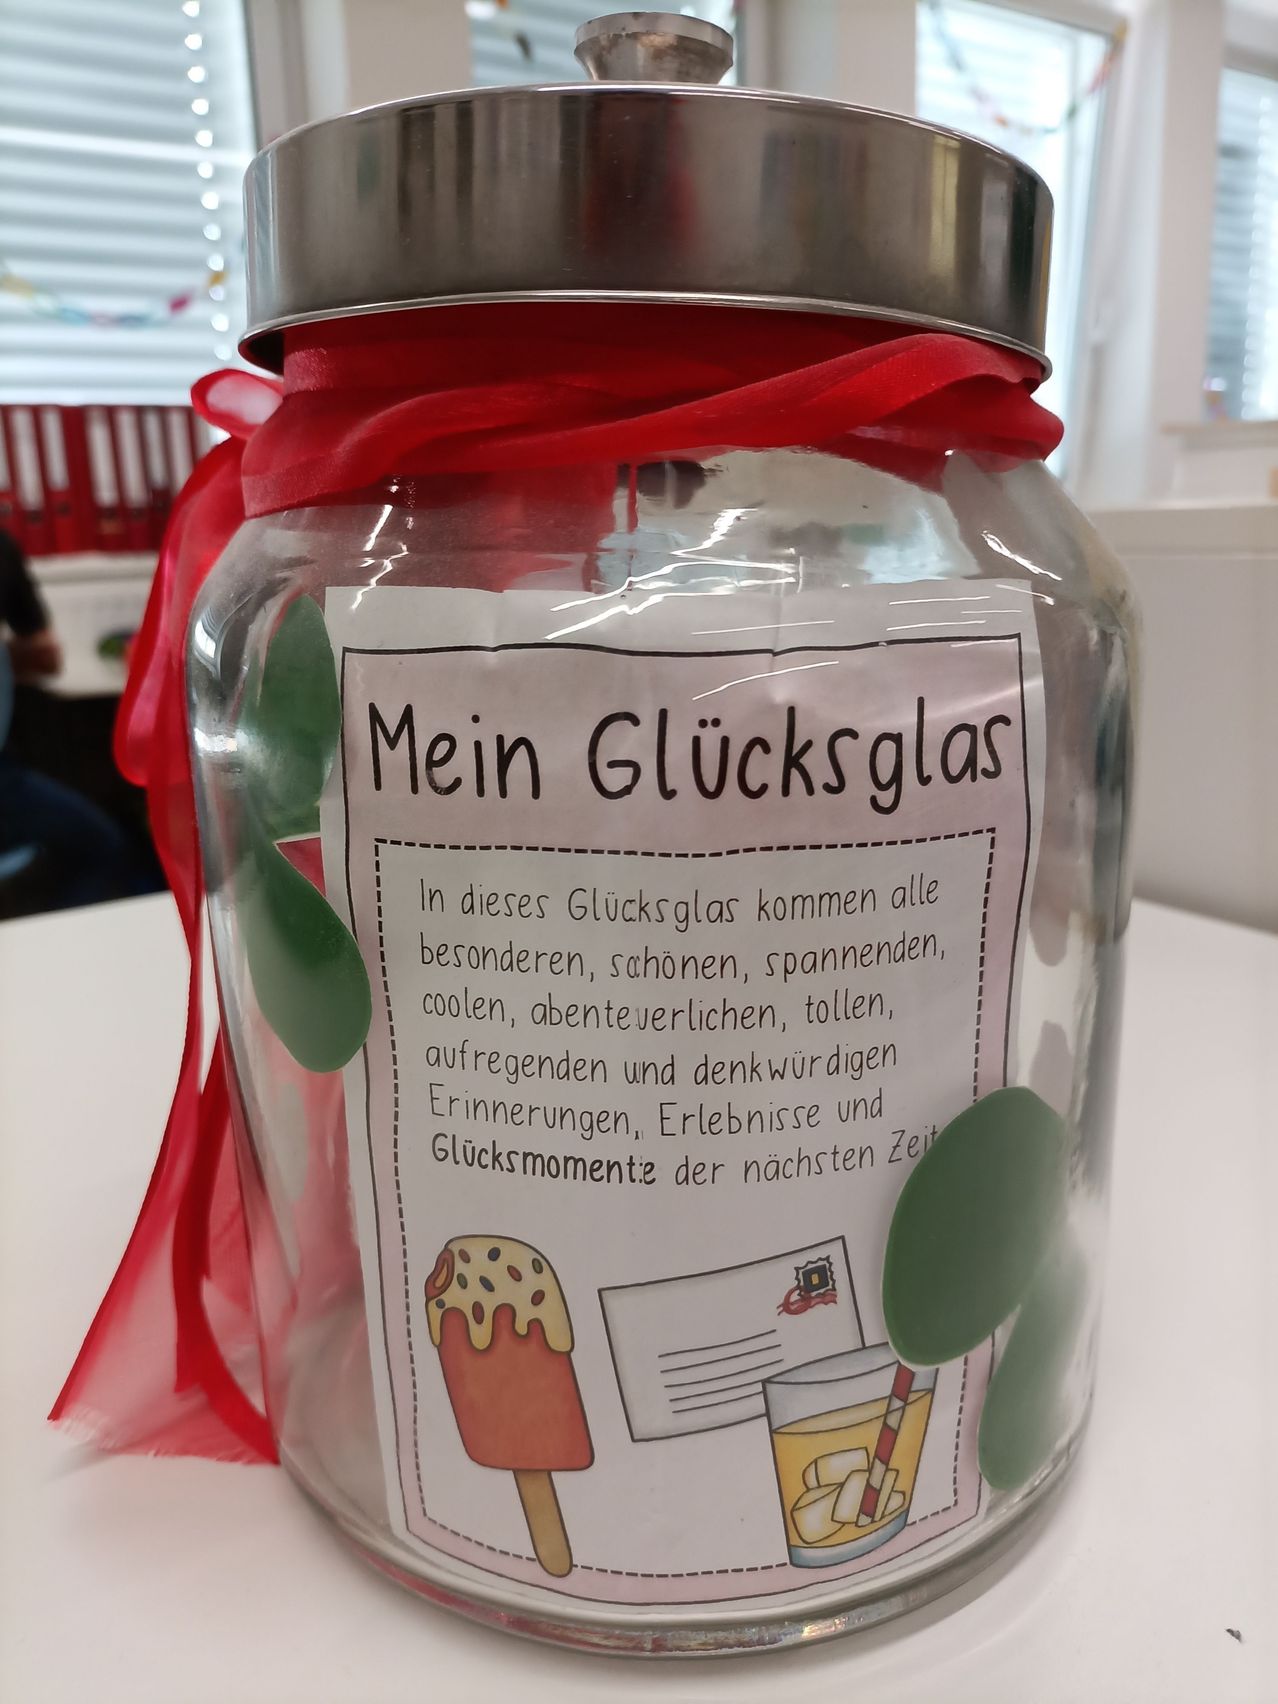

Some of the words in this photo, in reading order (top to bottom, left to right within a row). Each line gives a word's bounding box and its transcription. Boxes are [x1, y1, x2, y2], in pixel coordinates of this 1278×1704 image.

[368, 701, 541, 801] Mein
[587, 697, 1013, 816] Glücksglas
[419, 878, 445, 913] In
[460, 882, 550, 920] dieses
[567, 887, 740, 934] Glücksglas
[757, 887, 877, 920] kommen
[891, 872, 939, 910] alle
[419, 931, 595, 983] besonderen,
[609, 945, 749, 985] schönen,
[765, 931, 945, 981] spannenden,
[422, 986, 515, 1029] coolen,
[530, 991, 786, 1033] abenteuerlichen,
[804, 987, 893, 1024] tollen,
[425, 1039, 608, 1085] aufregenden
[623, 1053, 676, 1086] und
[693, 1043, 897, 1086] denkwürdigen
[428, 1083, 644, 1141] Erinnerungen,
[659, 1101, 821, 1137] Erlebnisse
[837, 1086, 883, 1123] und
[431, 1132, 657, 1186] Glücksmomente
[674, 1154, 726, 1186] der
[743, 1144, 875, 1184] nächsten
